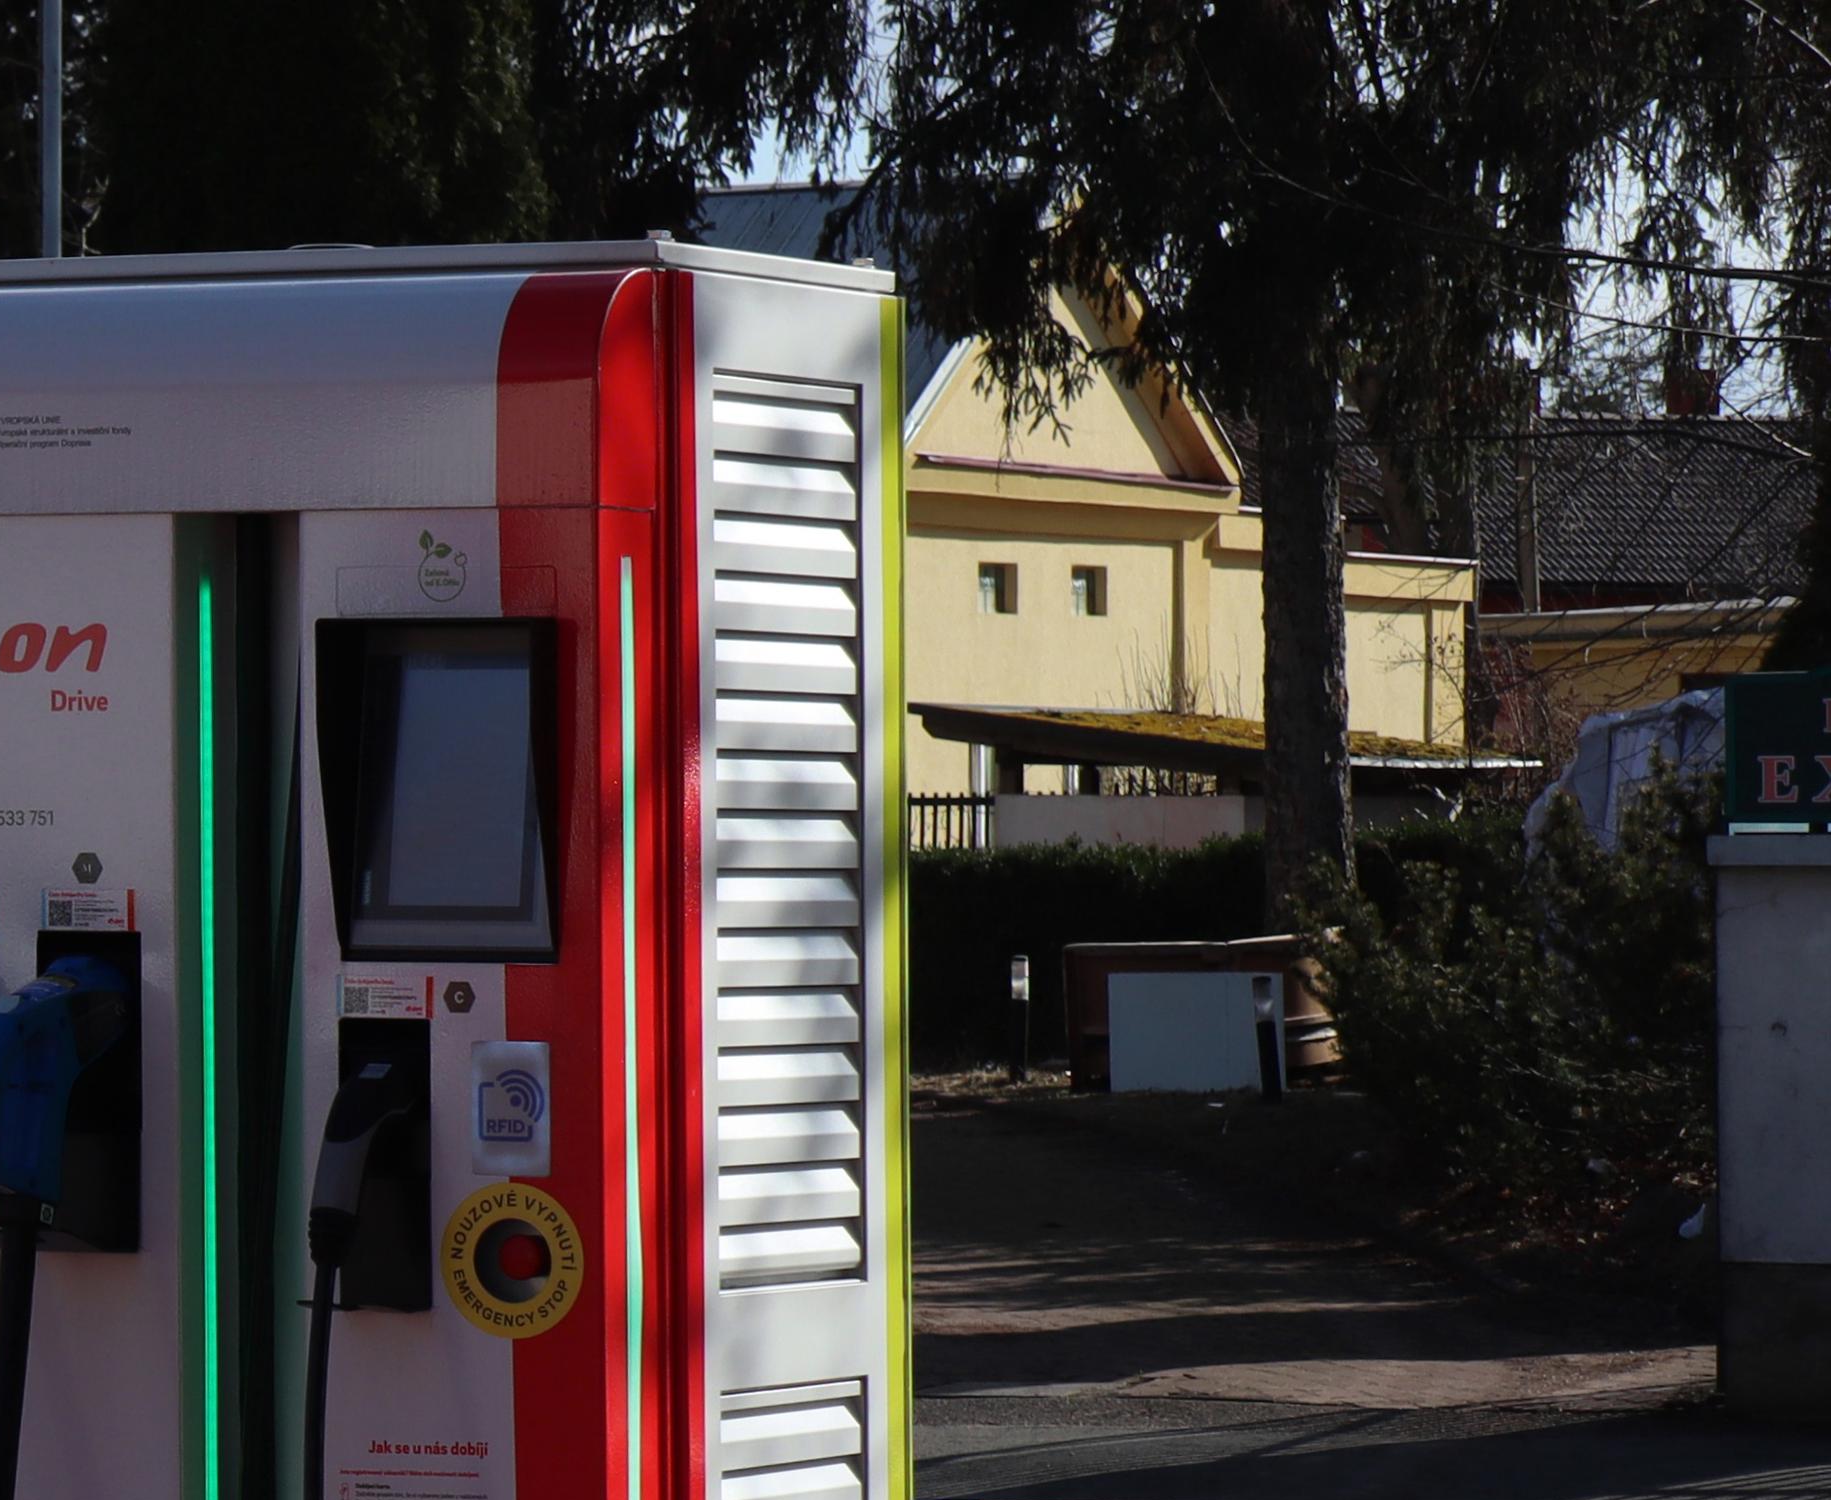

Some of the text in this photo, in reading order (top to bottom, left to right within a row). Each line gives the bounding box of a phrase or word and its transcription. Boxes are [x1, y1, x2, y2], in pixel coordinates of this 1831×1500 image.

[51, 690, 108, 711] Drive
[29, 810, 54, 826] 751
[454, 991, 464, 1004] C
[486, 1119, 526, 1133] RFID
[451, 1190, 578, 1271] NOUZOVÉ VYPNUTÍ
[454, 1270, 568, 1328] EMERGENCY STOP
[368, 1440, 392, 1454] Jak
[395, 1445, 409, 1454] se
[412, 1445, 421, 1454] u
[425, 1441, 447, 1455] nás
